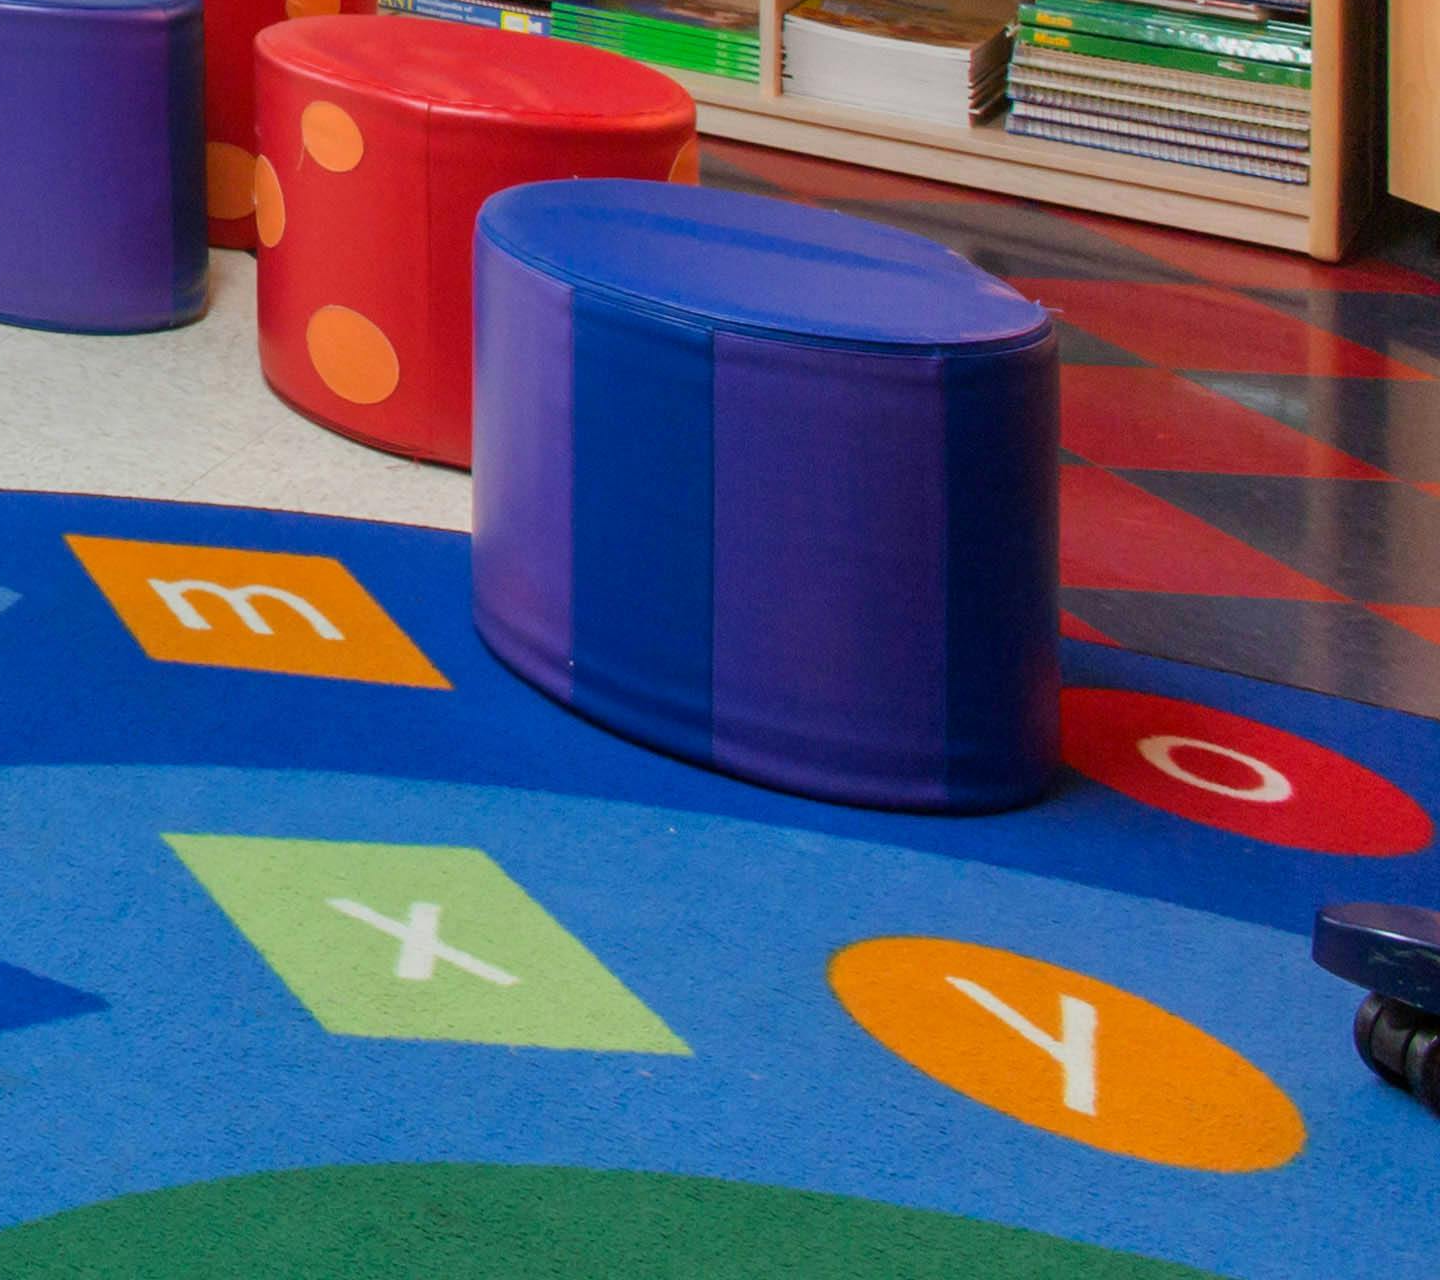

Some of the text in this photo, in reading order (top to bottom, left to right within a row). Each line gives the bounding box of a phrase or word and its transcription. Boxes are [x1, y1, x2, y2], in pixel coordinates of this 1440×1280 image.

[150, 579, 341, 640] m
[328, 896, 518, 987] x
[951, 976, 1098, 1116] y
